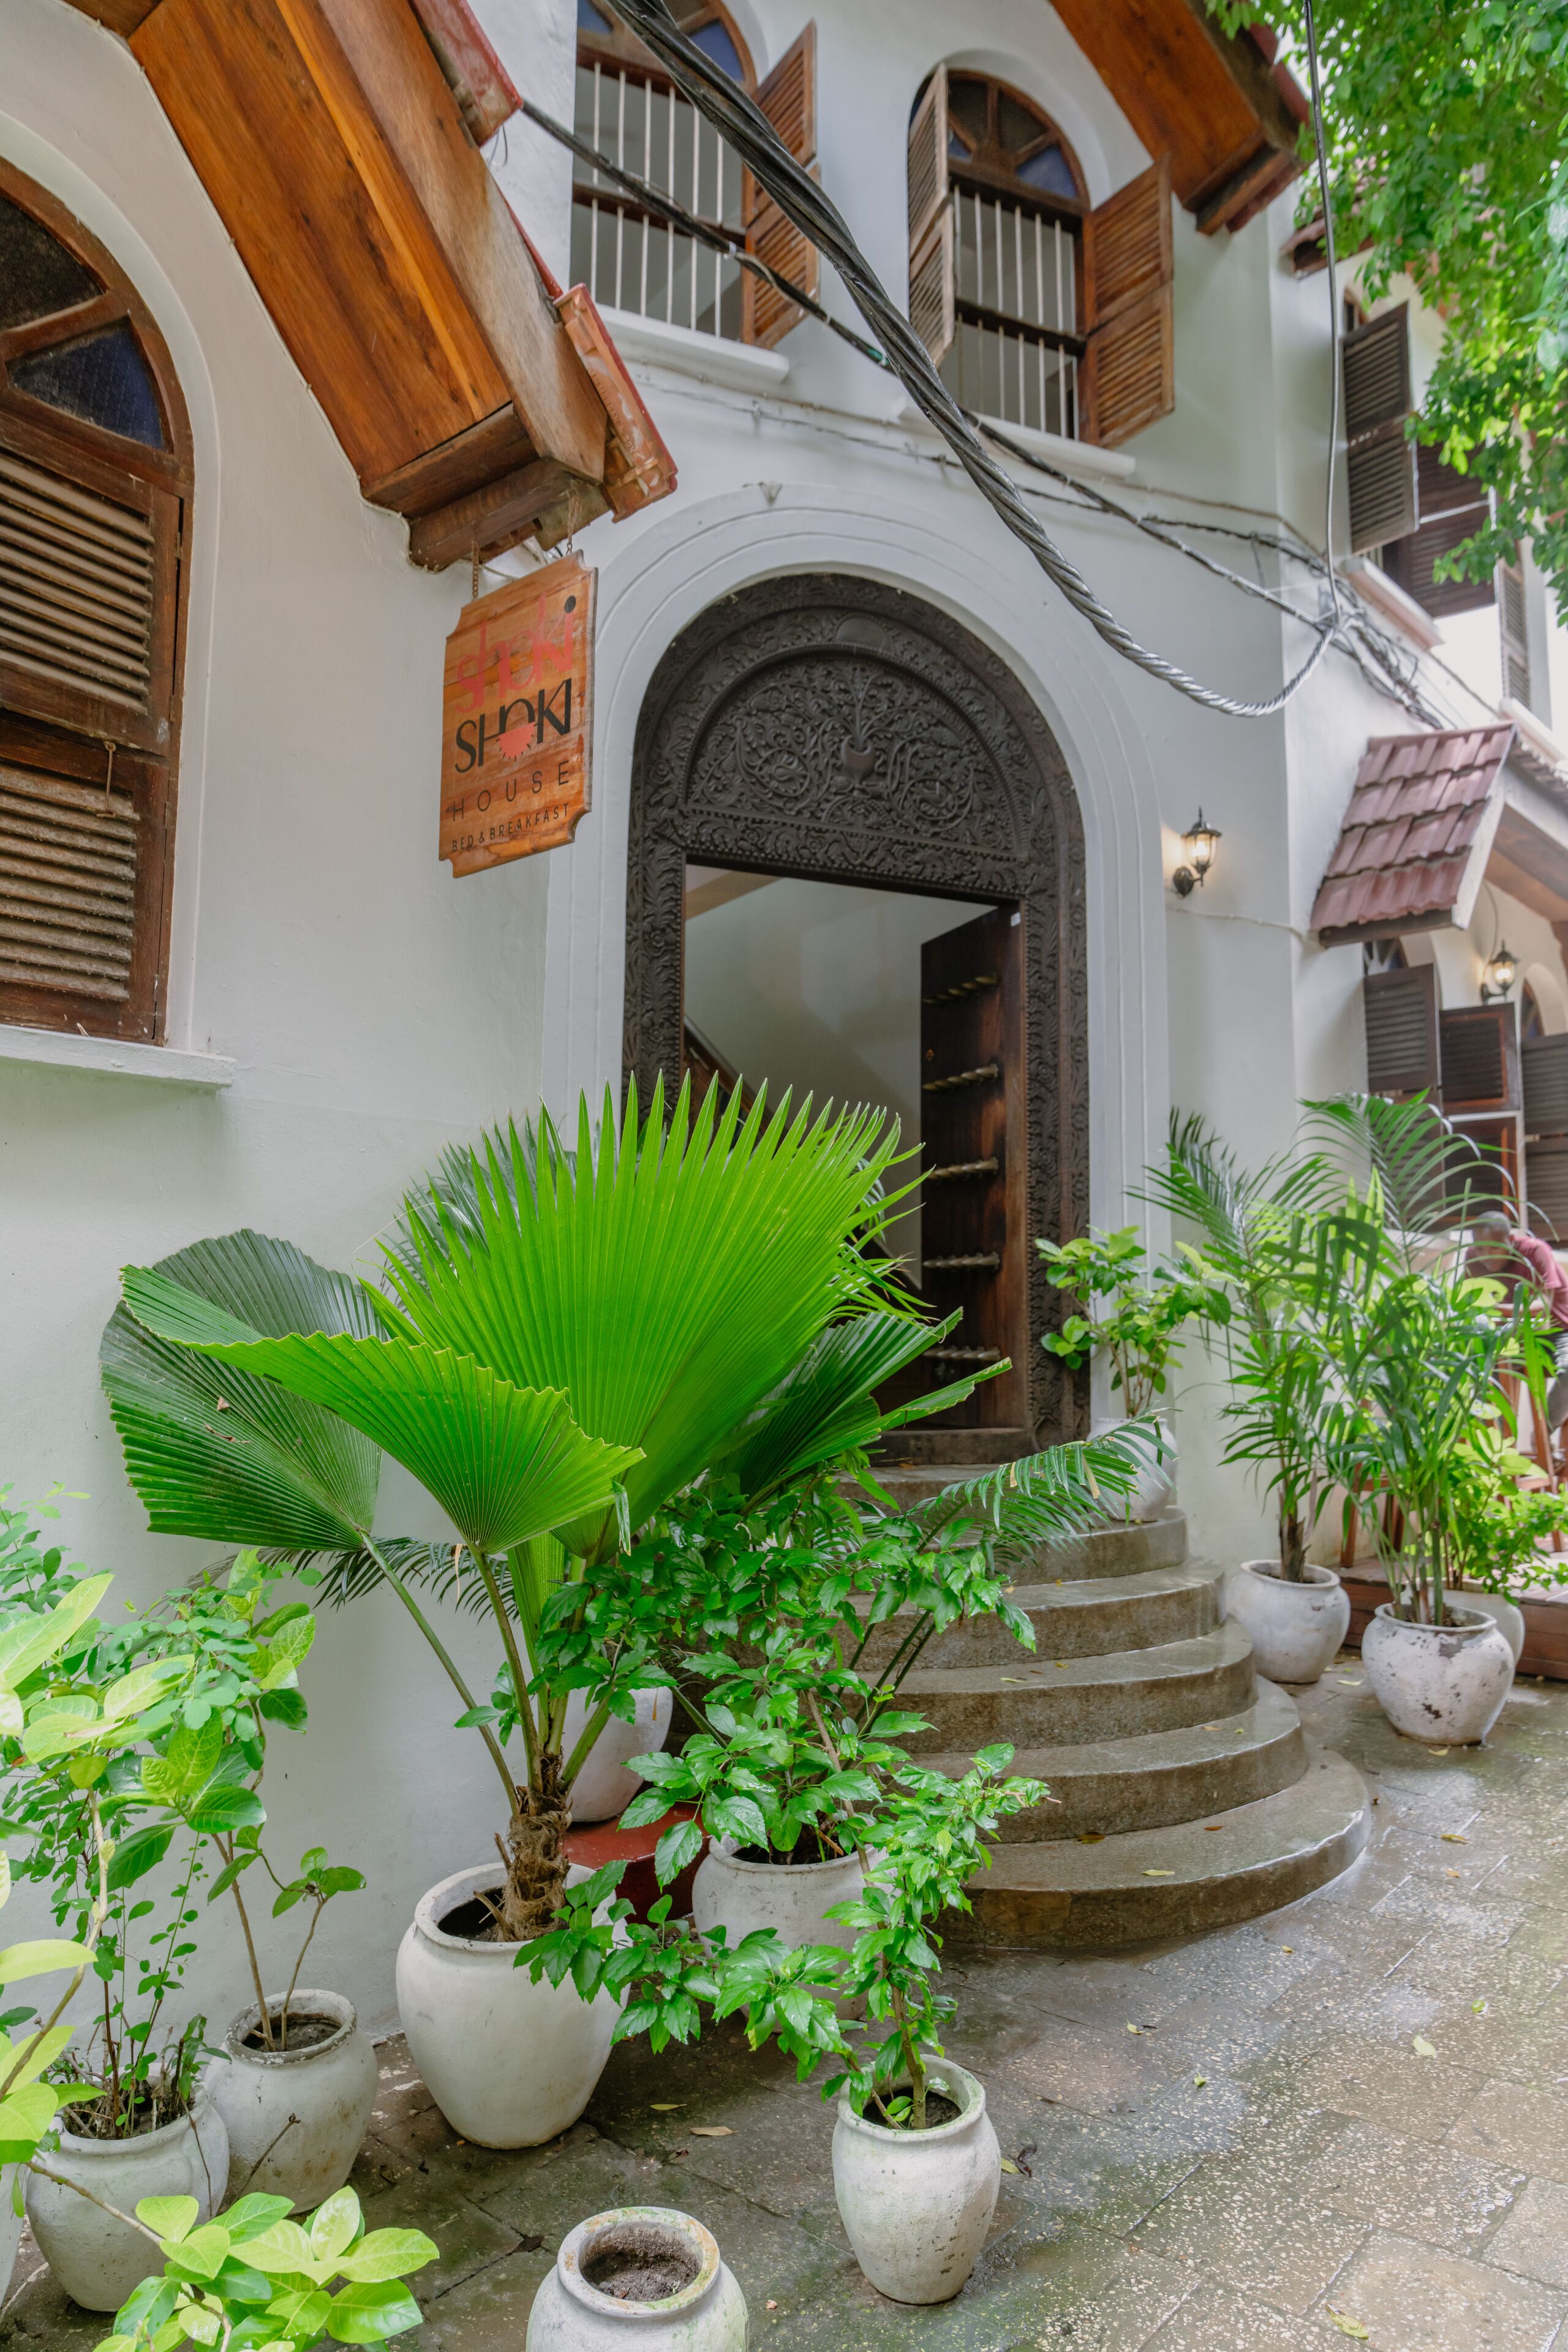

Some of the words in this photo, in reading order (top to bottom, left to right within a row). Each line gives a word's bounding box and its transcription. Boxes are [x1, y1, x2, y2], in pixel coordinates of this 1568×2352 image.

[454, 677, 571, 773] SHOKI
[453, 760, 569, 822] HOUSE
[452, 835, 474, 853] BED
[479, 831, 486, 843] &
[490, 803, 569, 840] BREAKFAST
